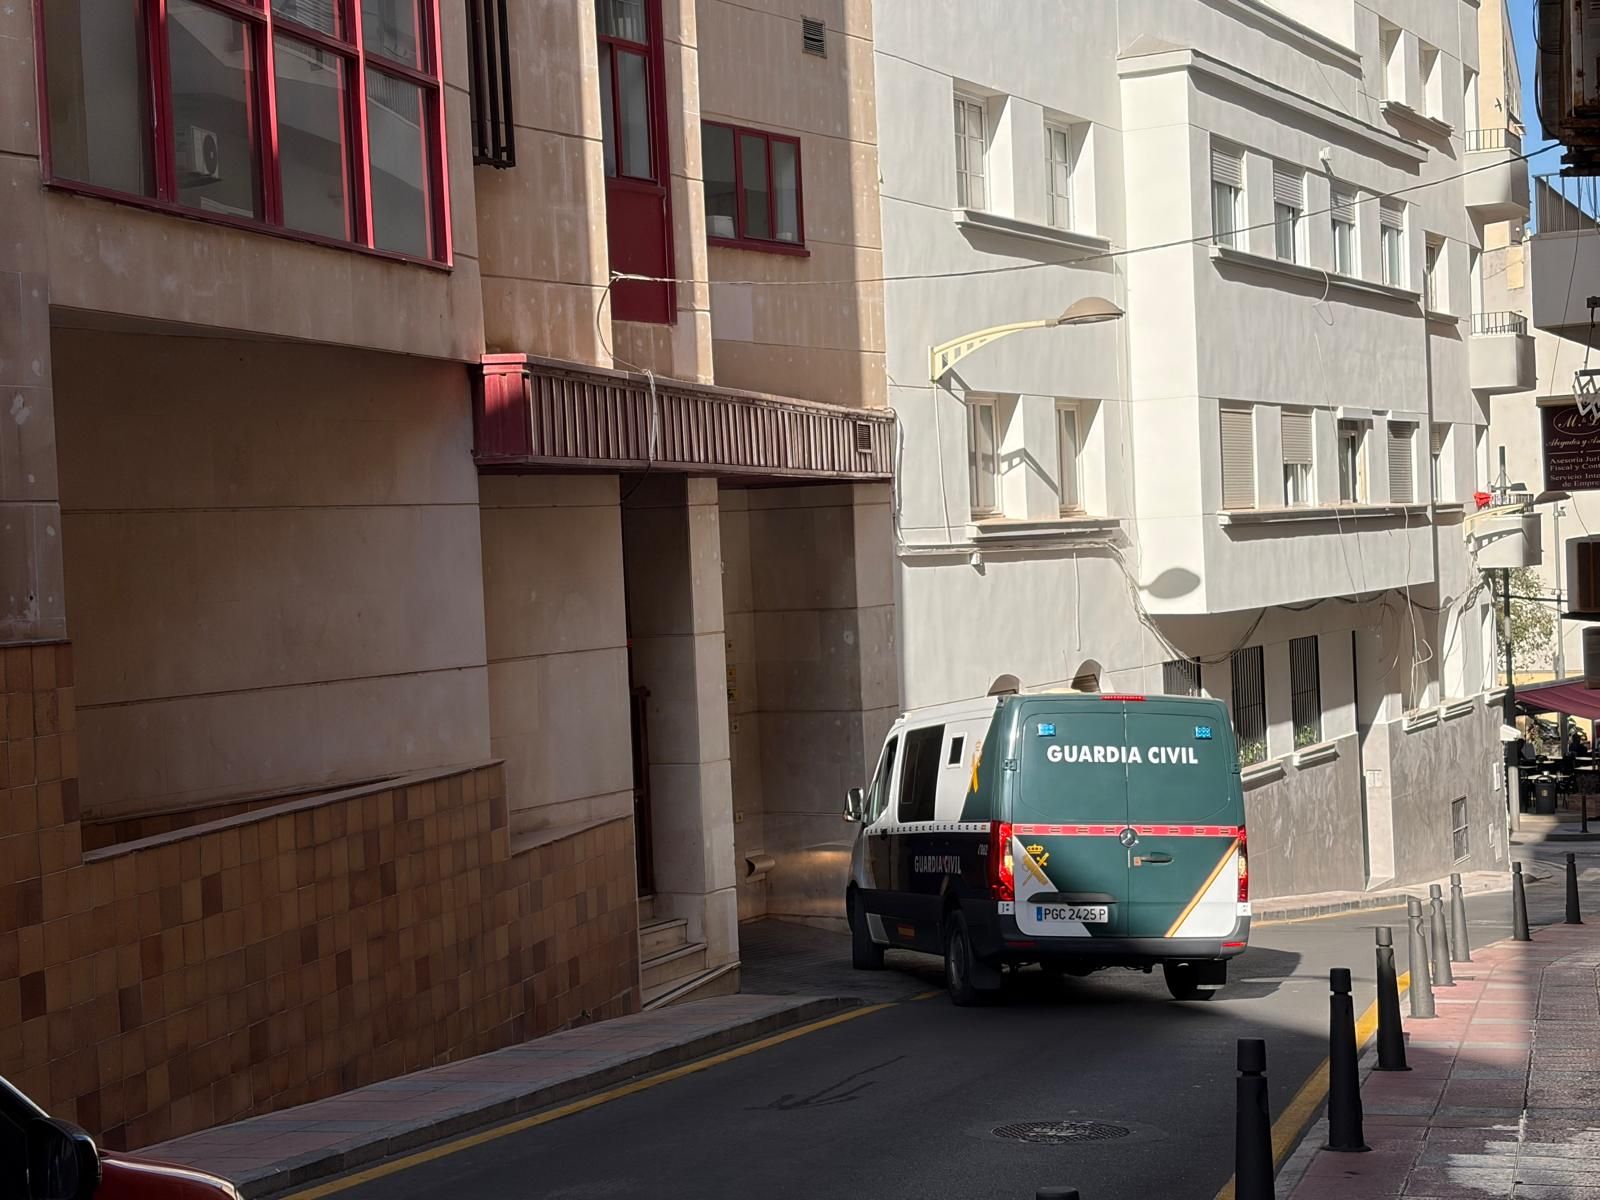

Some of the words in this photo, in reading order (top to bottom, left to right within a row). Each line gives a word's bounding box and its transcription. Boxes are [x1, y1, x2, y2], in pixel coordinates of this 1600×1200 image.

[1550, 464, 1573, 472] Fiscal
[1046, 745, 1142, 764] GUARDIA
[1147, 746, 1198, 764] CIVIL
[914, 856, 943, 873] GUARDIA
[943, 856, 962, 874] CIVIL
[1044, 908, 1066, 920] PGC
[1068, 908, 1097, 920] 2425
[1099, 908, 1106, 920] P
